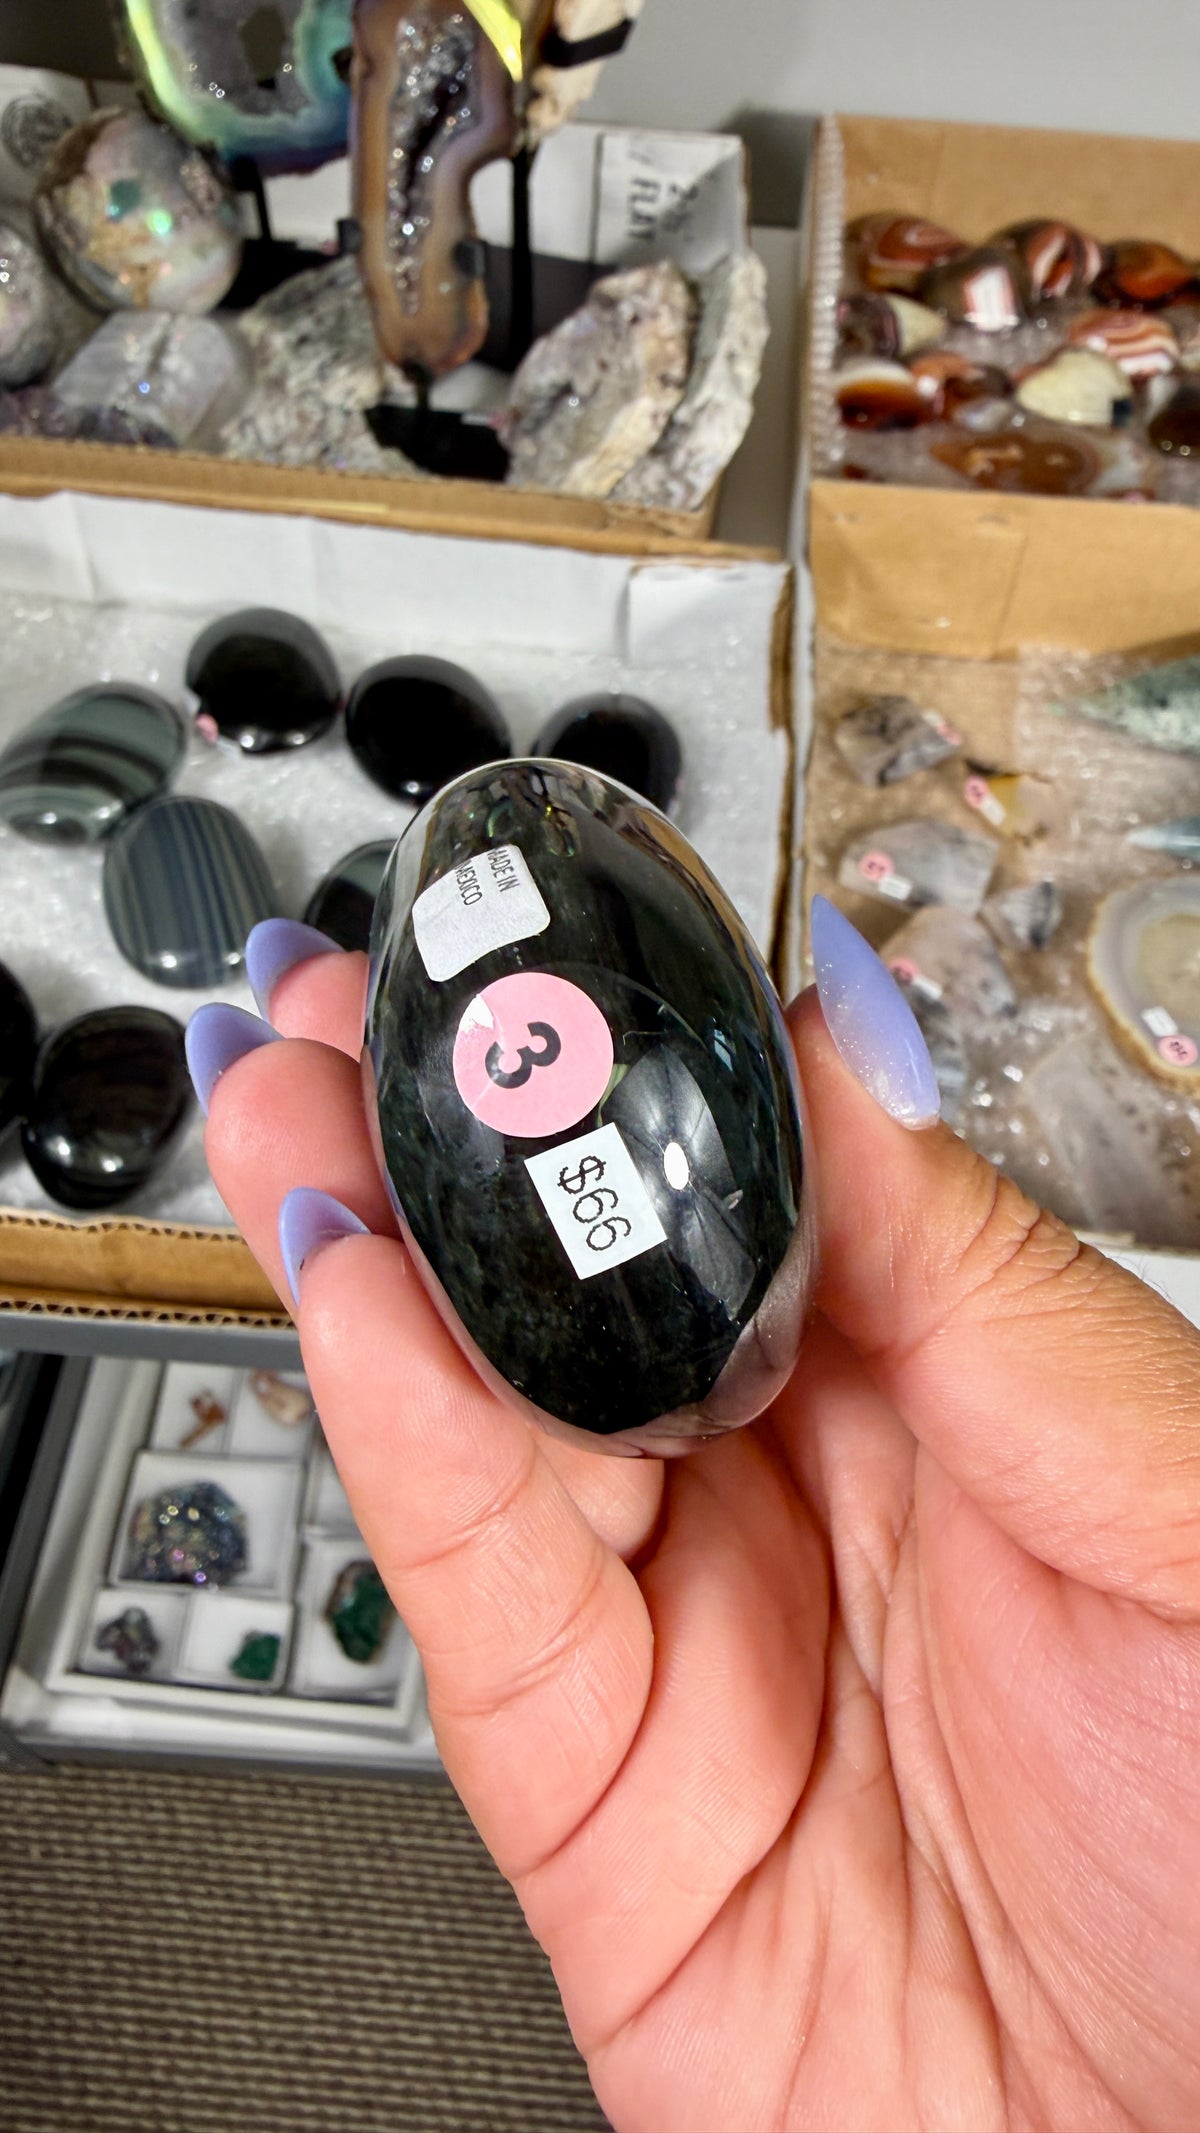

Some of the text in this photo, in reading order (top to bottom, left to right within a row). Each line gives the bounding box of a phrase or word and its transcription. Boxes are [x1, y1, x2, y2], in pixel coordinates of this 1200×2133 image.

[497, 874, 521, 893] IN
[484, 1021, 562, 1089] 3
[557, 1155, 632, 1251] $66
